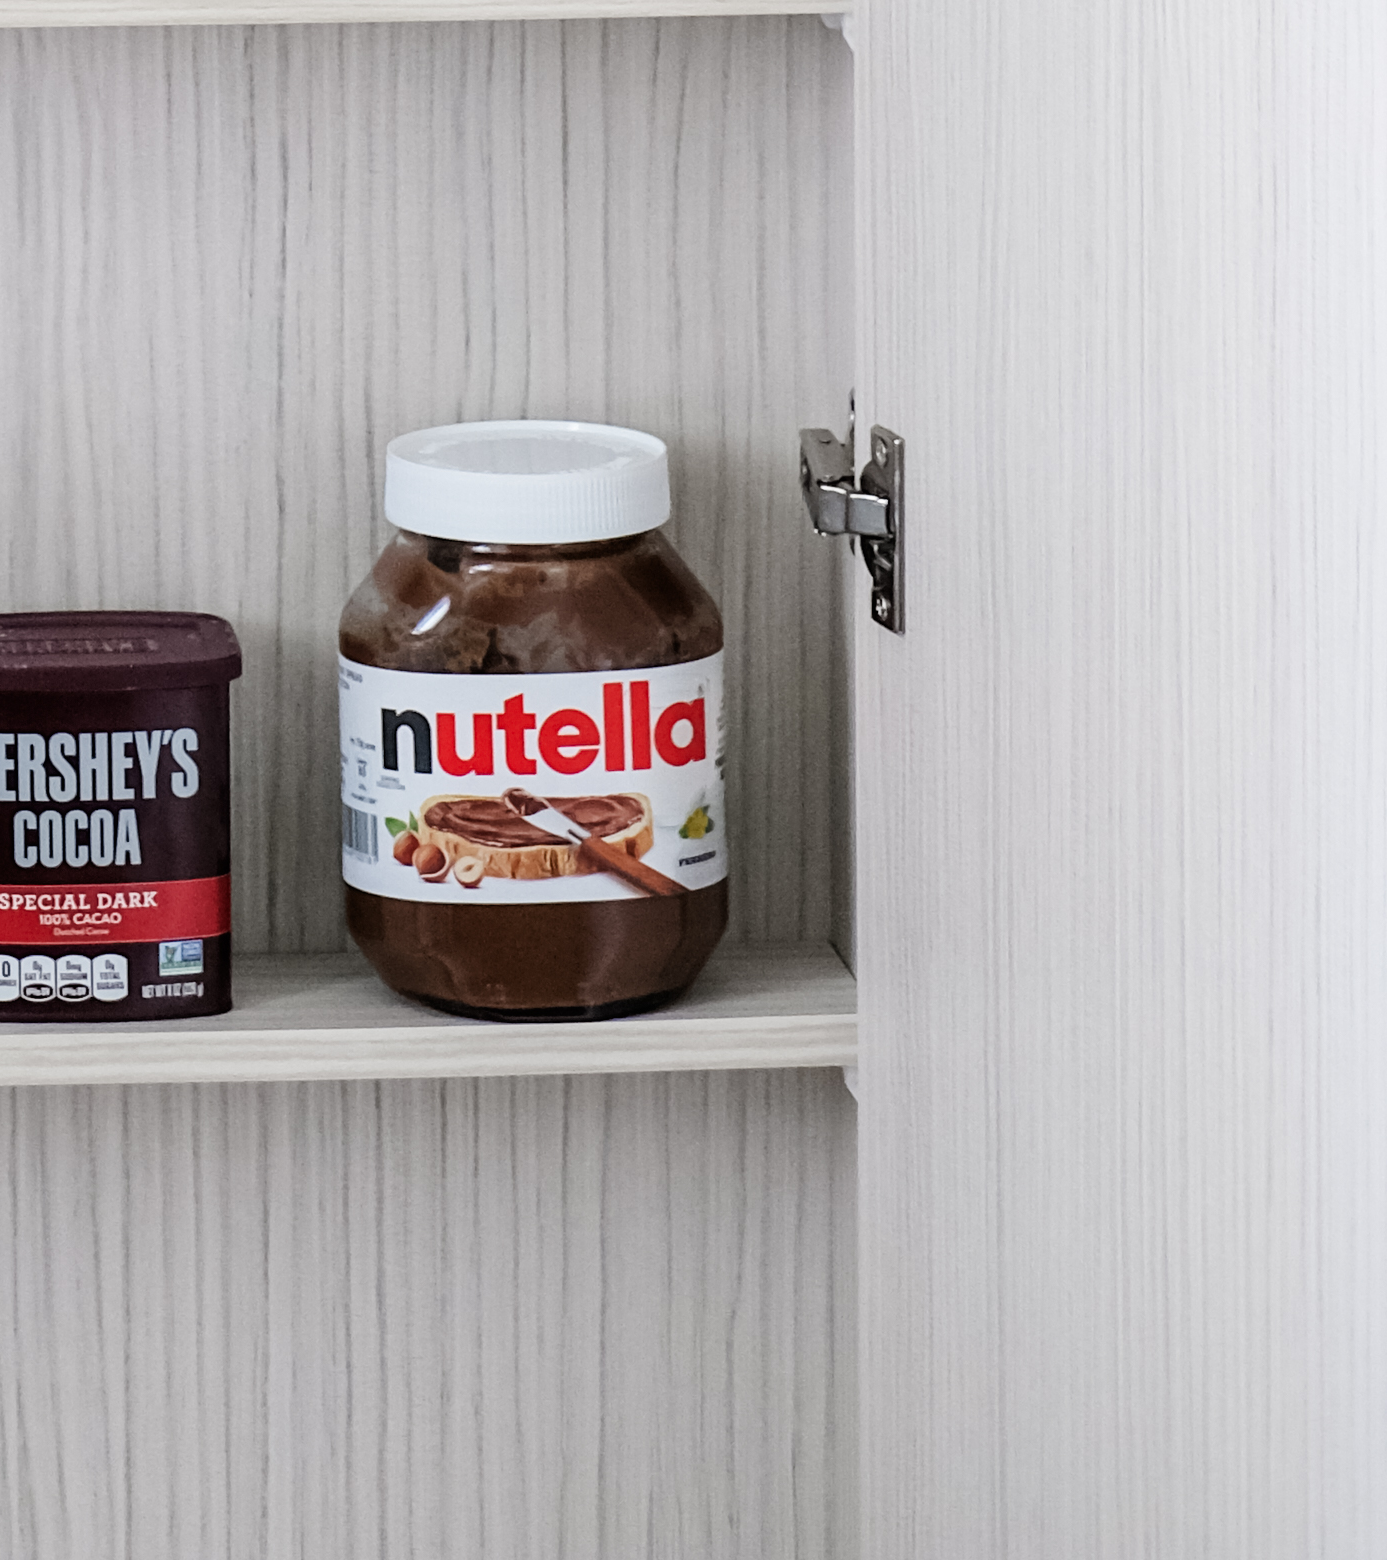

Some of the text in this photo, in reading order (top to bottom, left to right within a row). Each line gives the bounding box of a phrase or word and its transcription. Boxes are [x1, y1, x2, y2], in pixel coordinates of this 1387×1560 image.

[380, 681, 706, 776] nutella
[13, 808, 142, 868] COCOA
[39, 912, 122, 926] 100% CACAO
[96, 891, 158, 909] DARK
